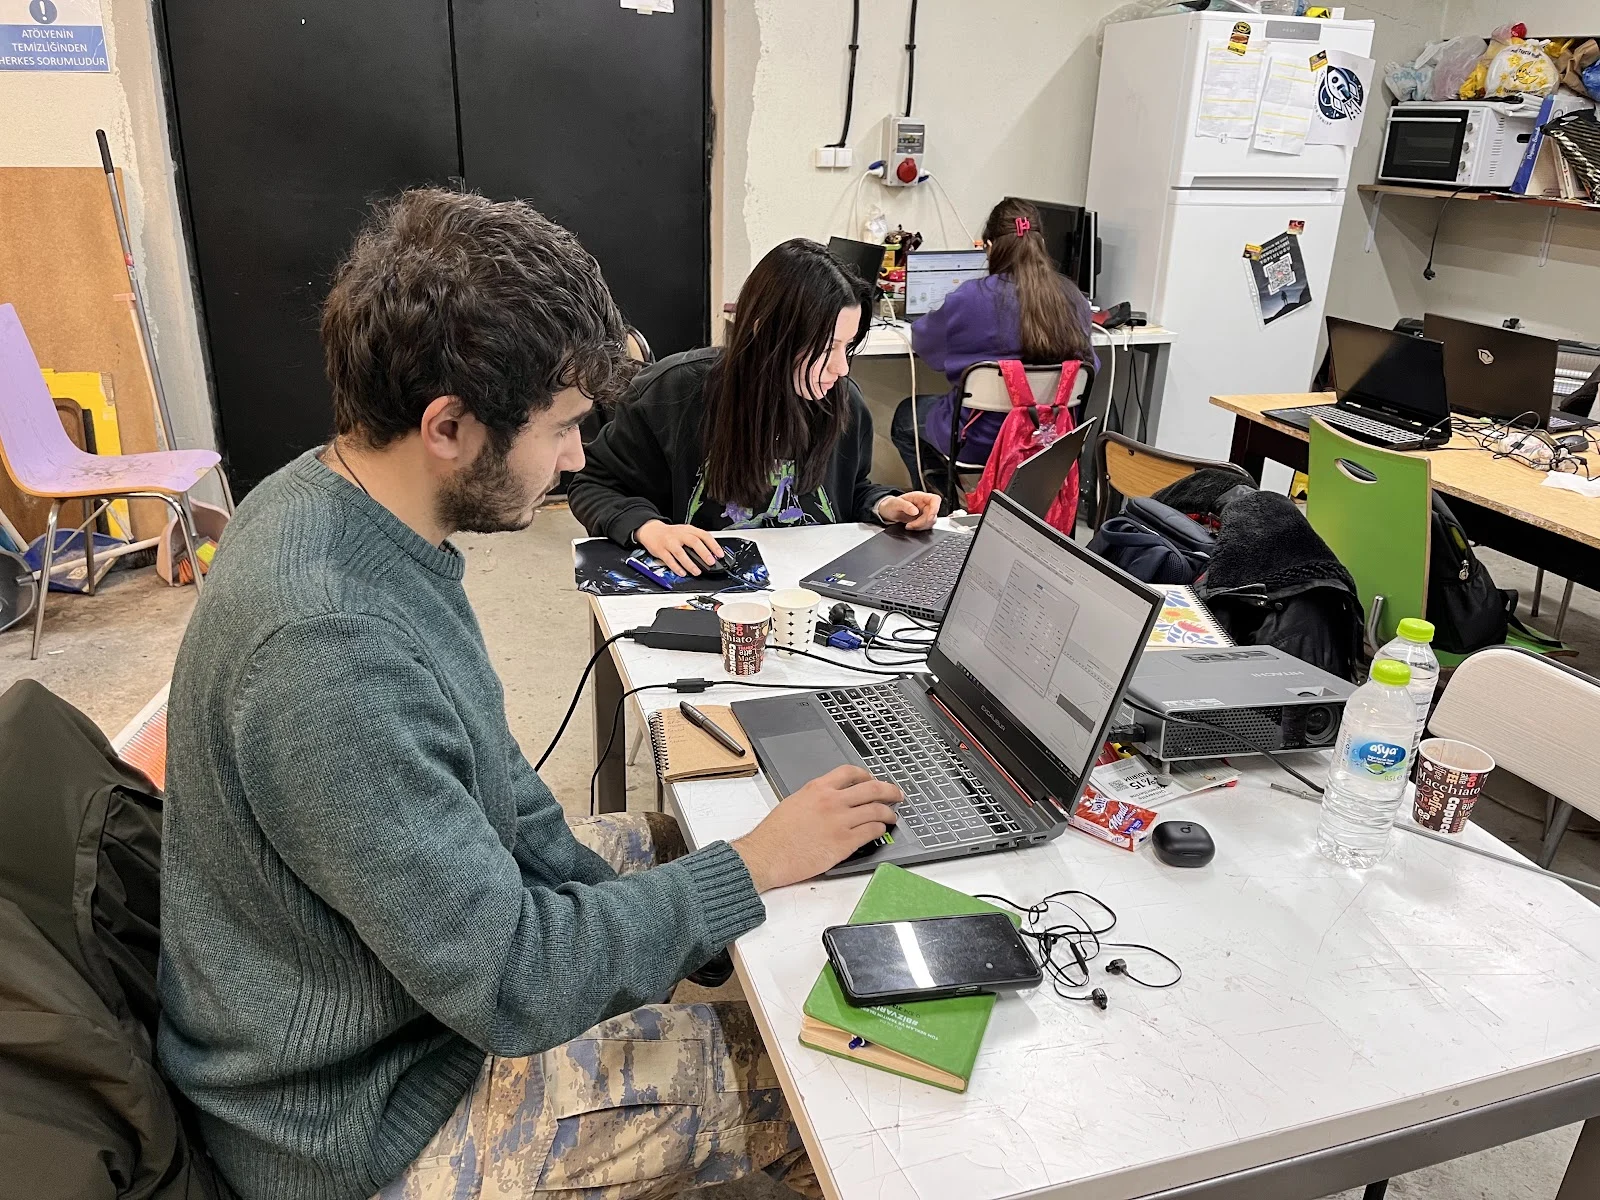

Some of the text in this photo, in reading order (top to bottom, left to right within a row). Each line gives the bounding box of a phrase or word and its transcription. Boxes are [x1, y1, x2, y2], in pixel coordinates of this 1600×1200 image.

[22, 28, 74, 39] ATÖLYENİN
[12, 42, 88, 53] TEMİZLİĞİNDEN
[0, 56, 106, 66] HERKES SORUMLUDUR
[1369, 743, 1397, 758] asya
[1419, 767, 1480, 796] Macchiato
[1414, 801, 1430, 820] Tea
[1428, 790, 1444, 816] Coffee
